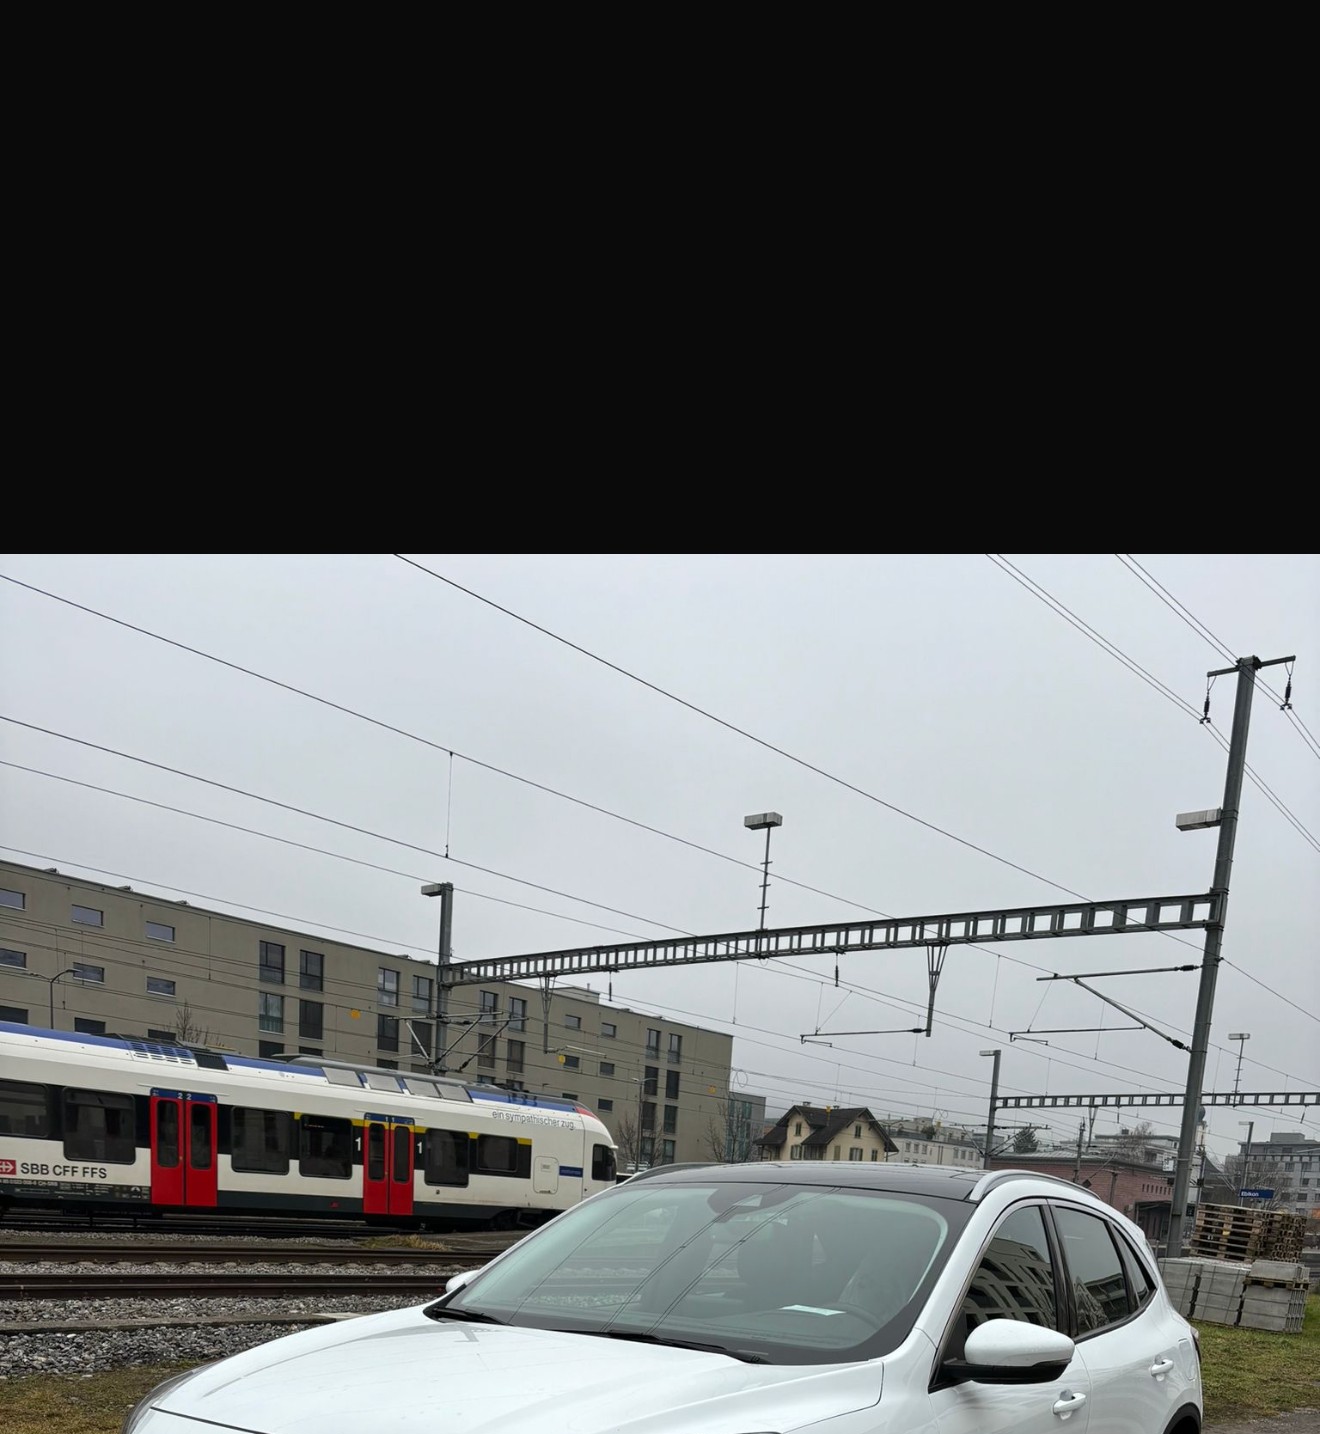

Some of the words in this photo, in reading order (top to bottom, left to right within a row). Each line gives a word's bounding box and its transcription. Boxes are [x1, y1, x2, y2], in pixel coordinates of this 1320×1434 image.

[492, 1110, 504, 1120] ein
[505, 1111, 560, 1127] sympathischer
[355, 1136, 361, 1152] 1
[417, 1141, 423, 1154] 1
[20, 1162, 50, 1175] SBB
[52, 1164, 79, 1177] CFF
[82, 1166, 107, 1179] FFS
